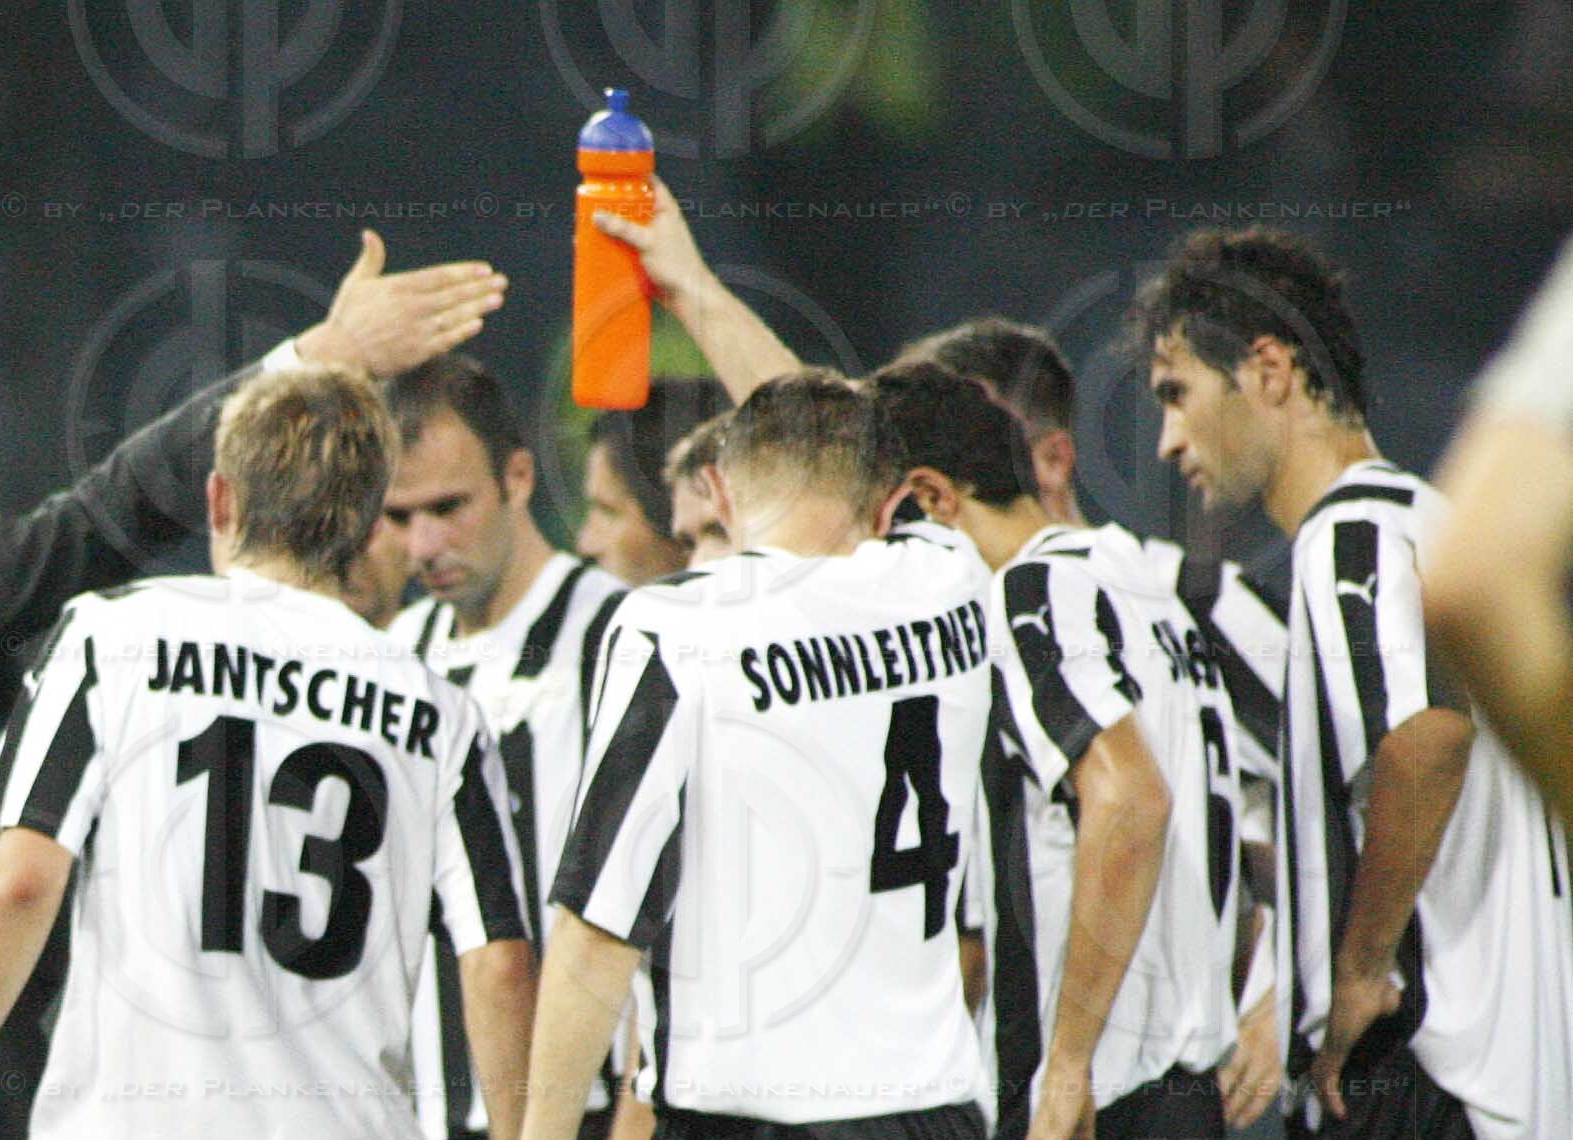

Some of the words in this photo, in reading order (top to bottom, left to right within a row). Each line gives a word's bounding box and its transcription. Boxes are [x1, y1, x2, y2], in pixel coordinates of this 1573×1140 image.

[147, 637, 441, 760] JANTSCHER
[869, 693, 960, 942] 4
[174, 713, 389, 981] 13
